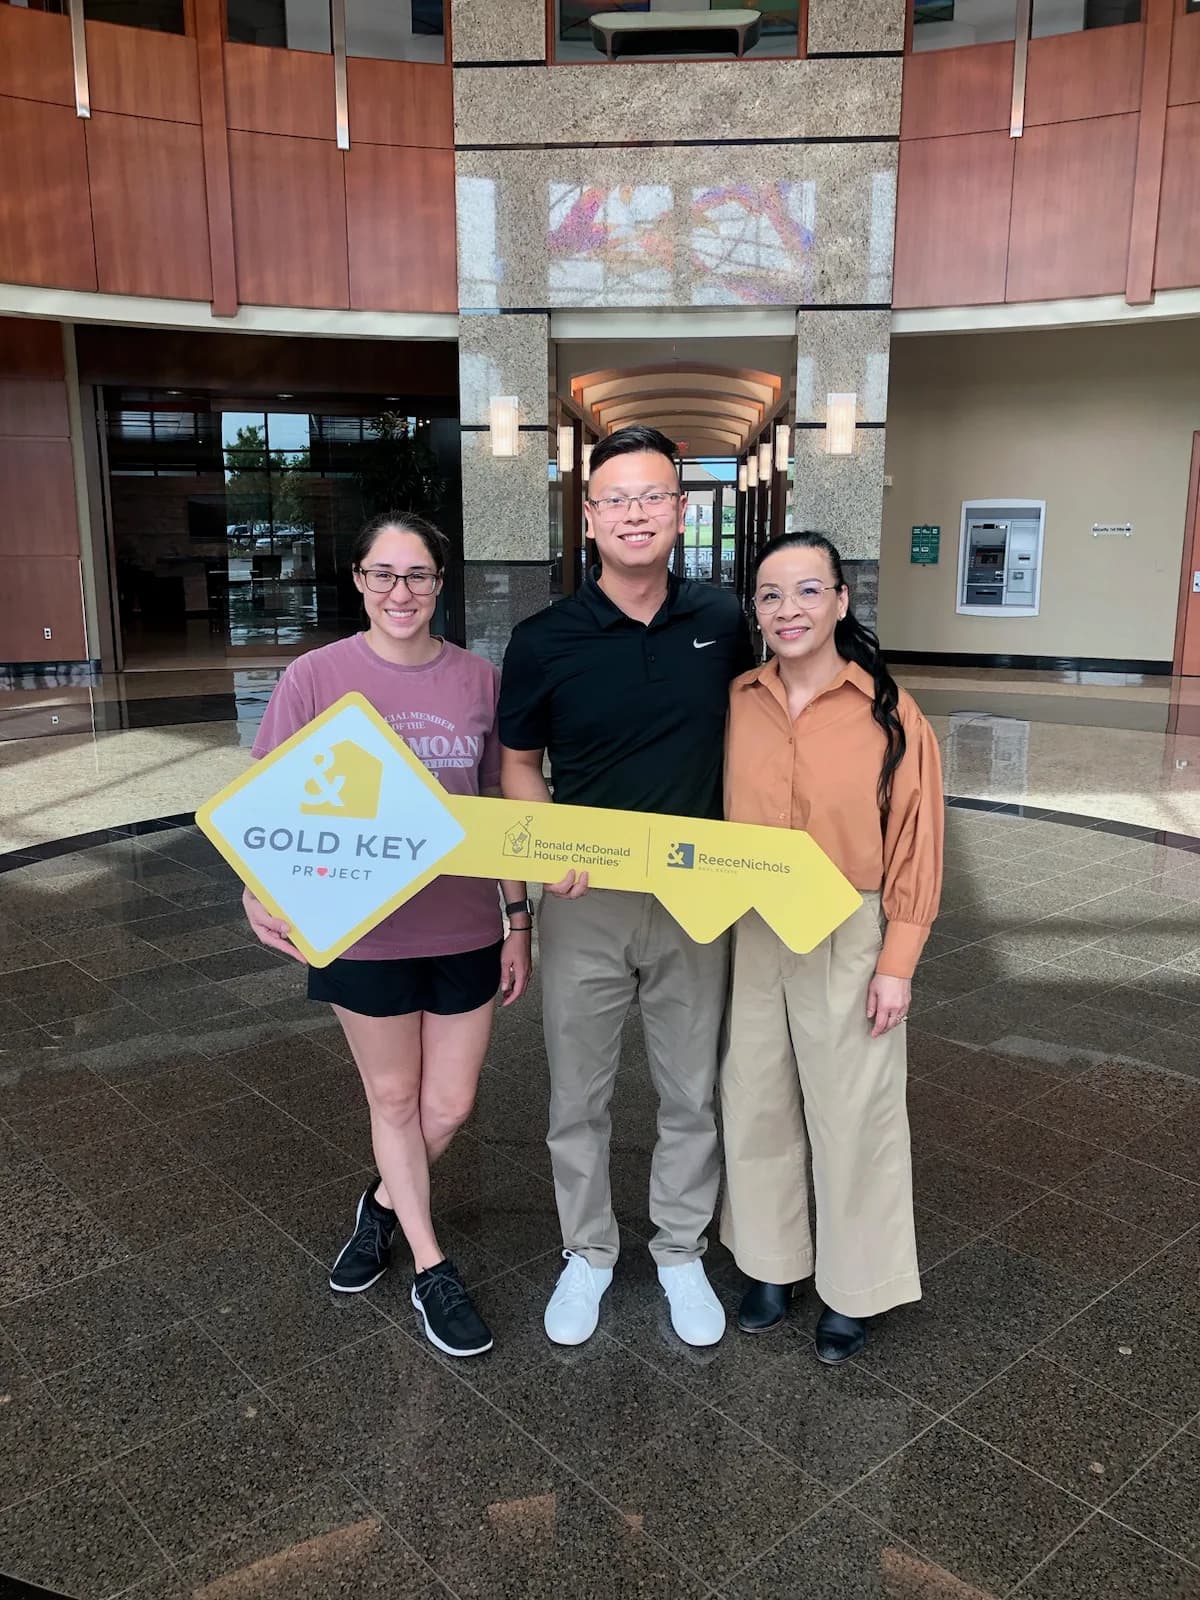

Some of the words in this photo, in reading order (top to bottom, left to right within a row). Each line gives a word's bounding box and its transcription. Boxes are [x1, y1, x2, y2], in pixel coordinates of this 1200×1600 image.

[384, 711, 409, 723] CIAL
[410, 711, 456, 732] MEMBER
[392, 722, 405, 731] OF
[406, 721, 426, 730] THE
[408, 735, 480, 757] MOAN
[243, 826, 340, 855] GOLD
[356, 834, 428, 861] KEY
[534, 839, 573, 851] Ronald
[575, 843, 631, 857] McDonald
[534, 851, 569, 862] House
[571, 853, 620, 867] Charities
[698, 853, 791, 874] ReeceNichols
